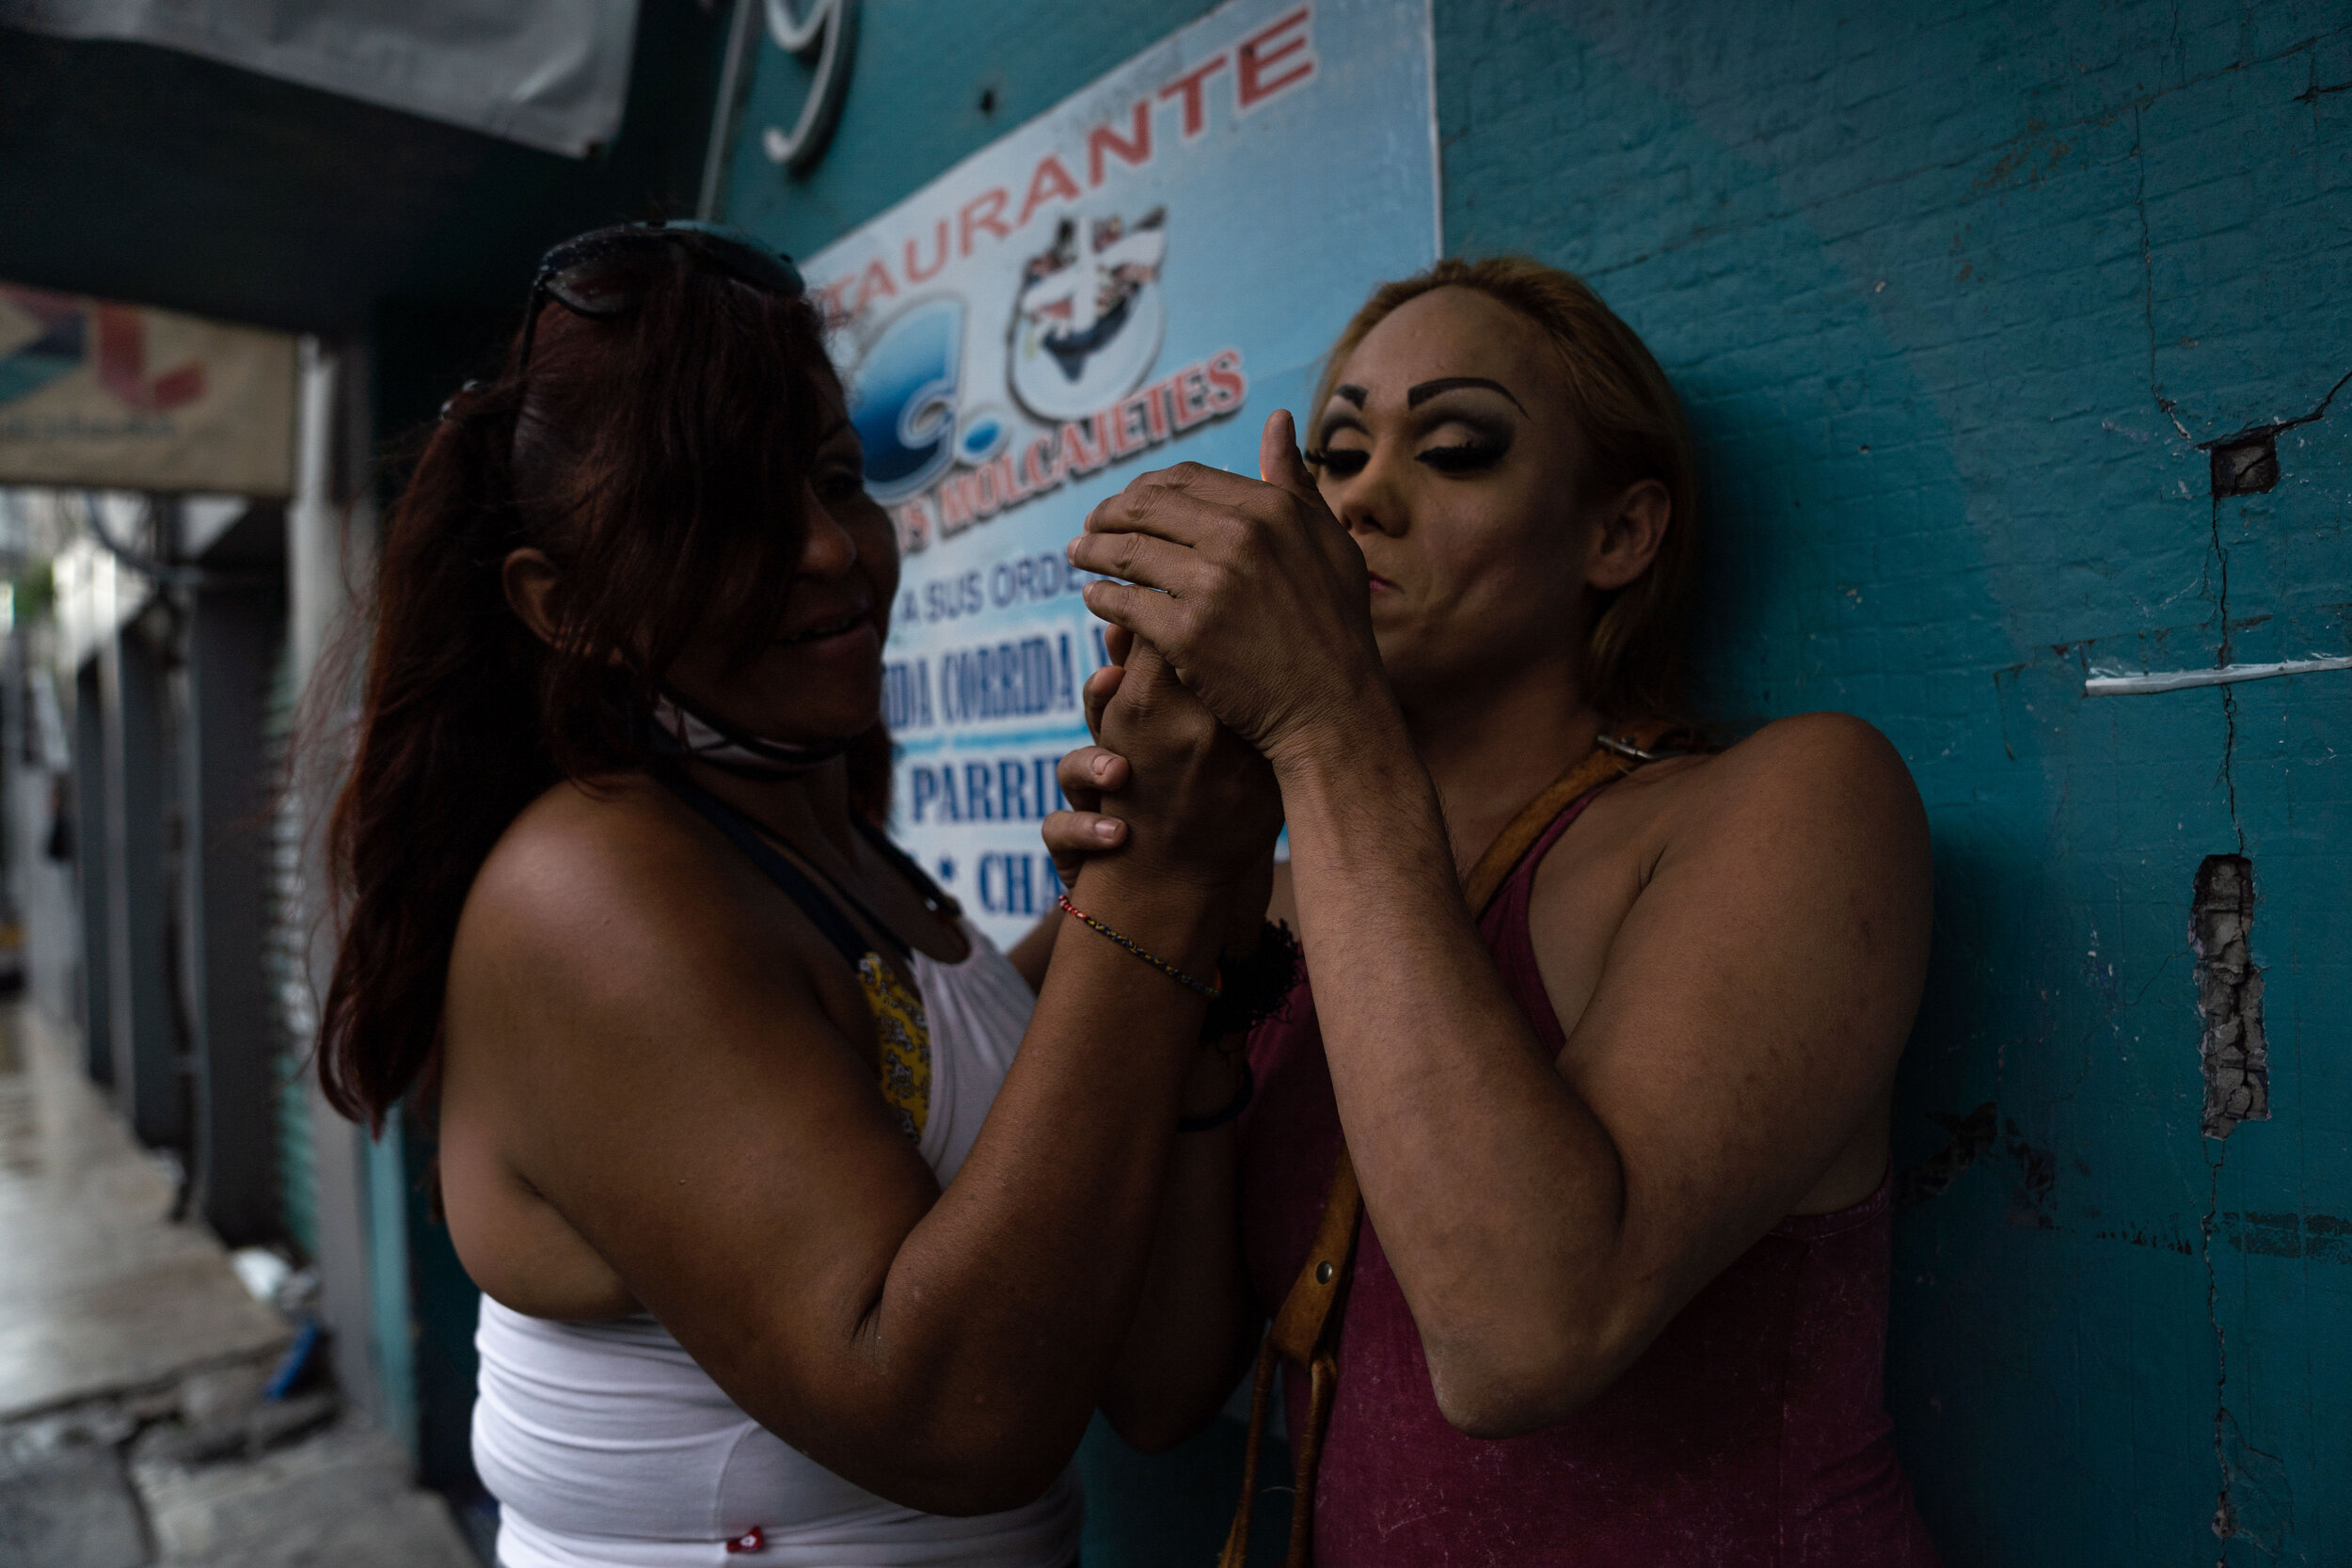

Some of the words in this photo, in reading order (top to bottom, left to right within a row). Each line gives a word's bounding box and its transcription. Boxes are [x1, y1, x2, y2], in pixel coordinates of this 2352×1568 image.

[935, 348, 1247, 531] MOLCAJETES
[925, 568, 983, 623] SUS
[989, 548, 1110, 609] ORDE
[939, 631, 1075, 722] CORRIDA
